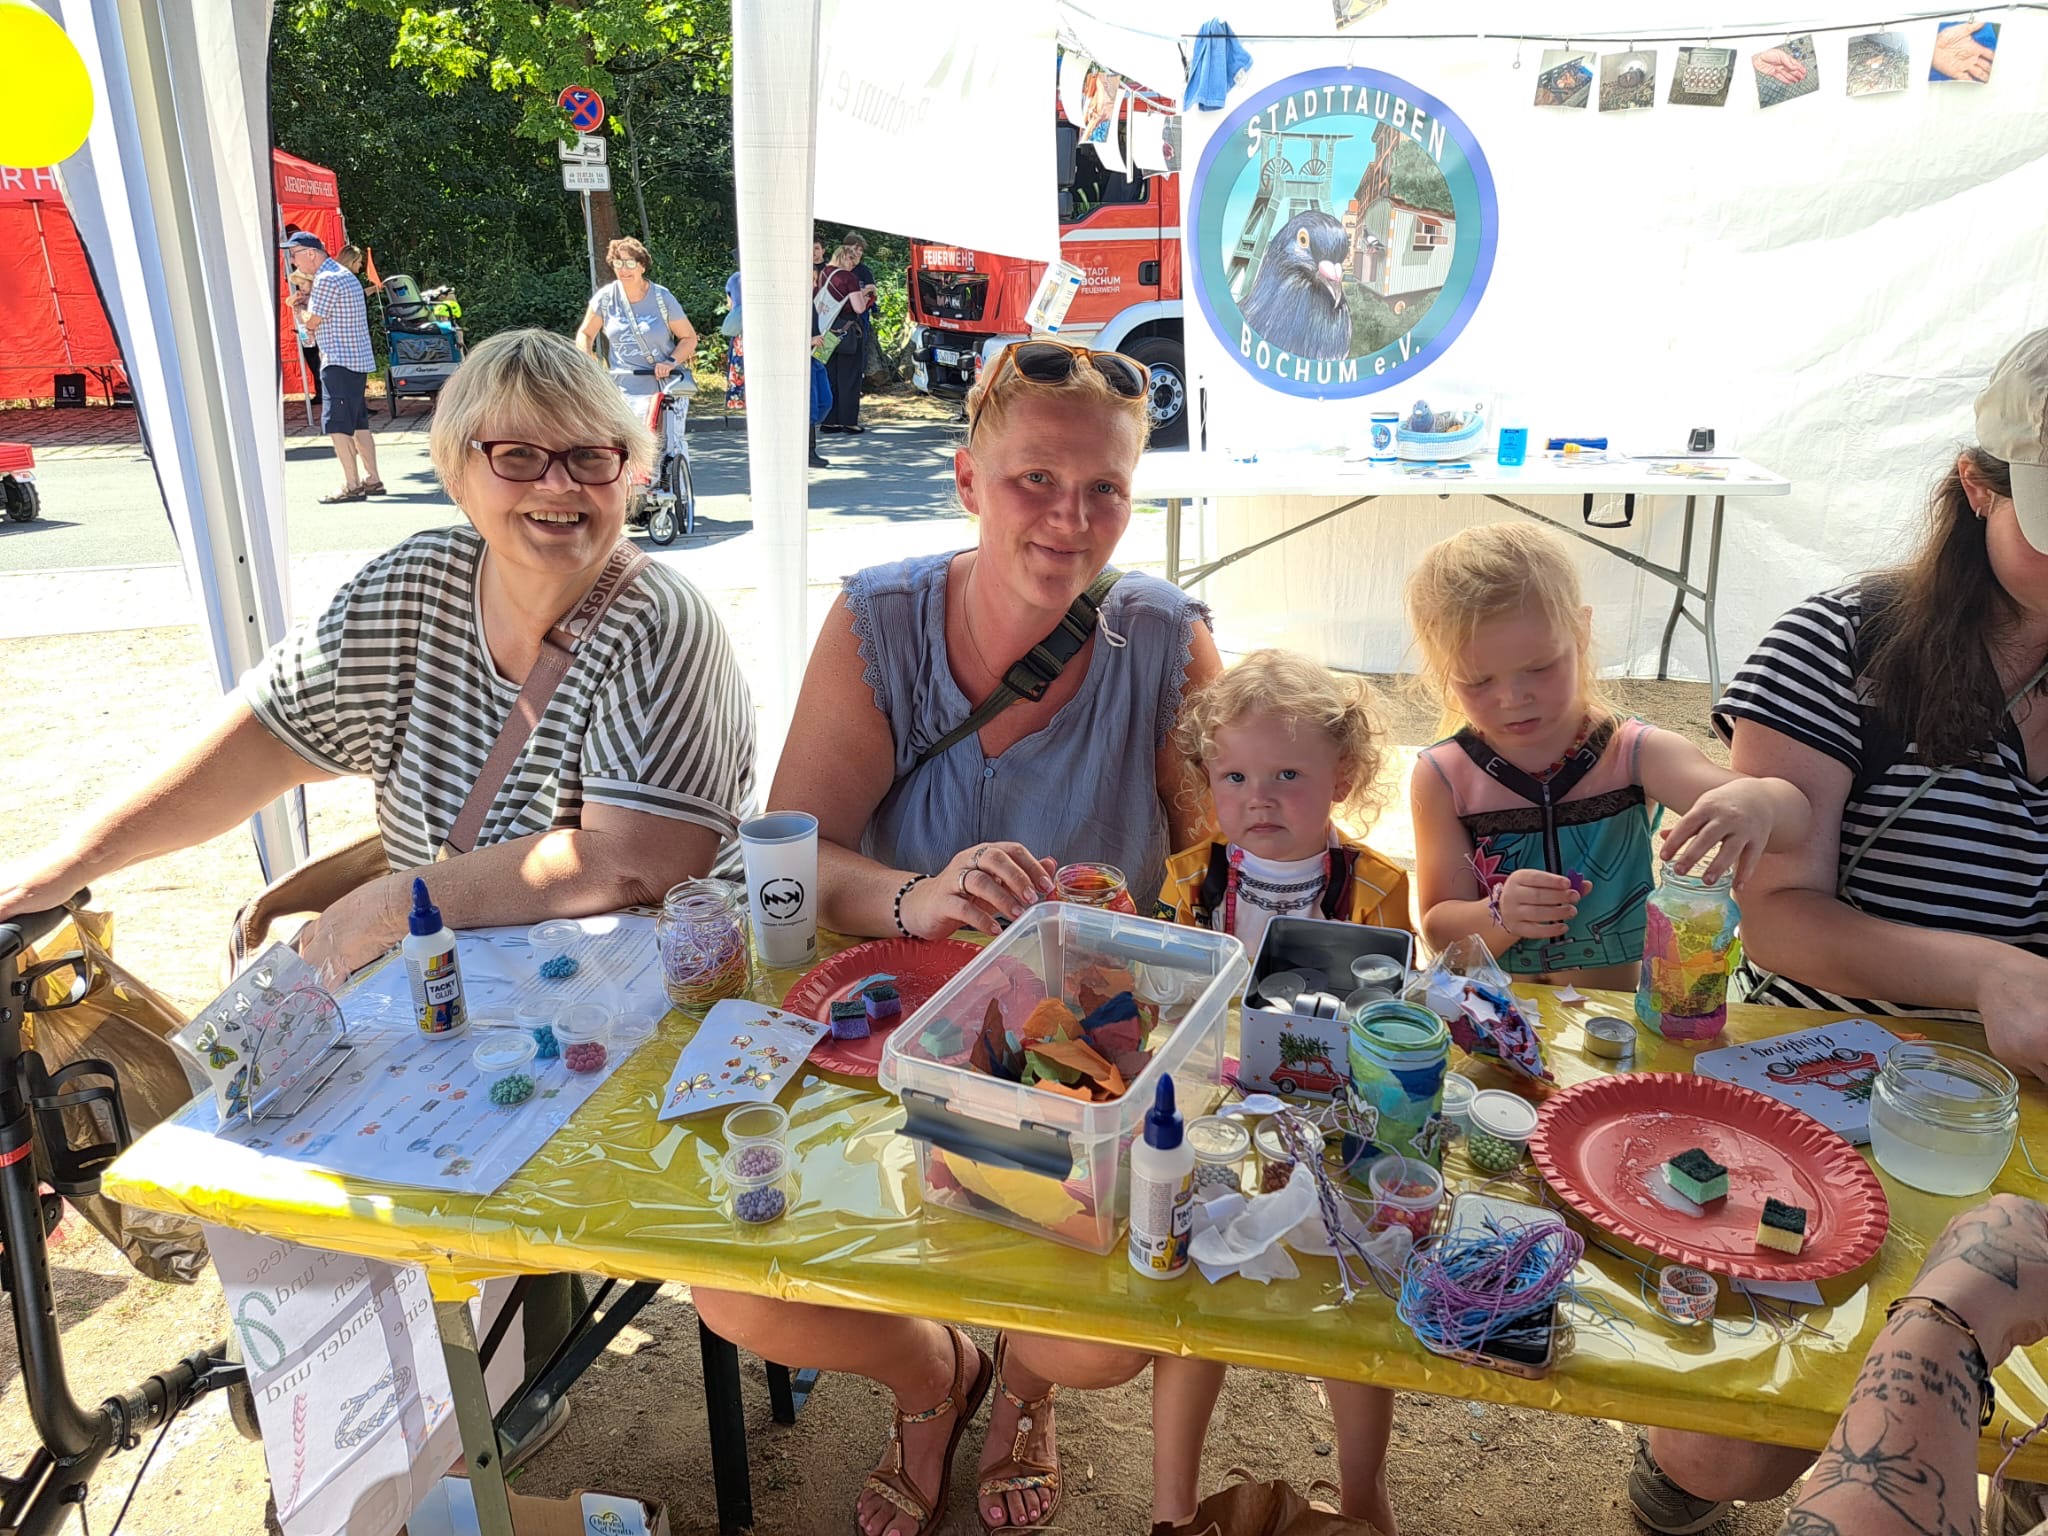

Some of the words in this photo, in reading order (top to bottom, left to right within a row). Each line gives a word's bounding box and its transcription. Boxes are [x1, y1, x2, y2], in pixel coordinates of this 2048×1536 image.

[1246, 85, 1446, 163] STADTTAUBEN
[923, 249, 975, 266] FEUERWEHR
[1080, 276, 1121, 286] BOCHUM
[1080, 286, 1121, 294] FEUERWEHR
[1240, 320, 1358, 384] BOCHUM
[1374, 331, 1421, 376] e.V.
[428, 979, 456, 994] TACKY
[434, 989, 454, 1000] GLUE
[1750, 1034, 1836, 1058] Christmas
[1783, 1051, 1838, 1069] Merry
